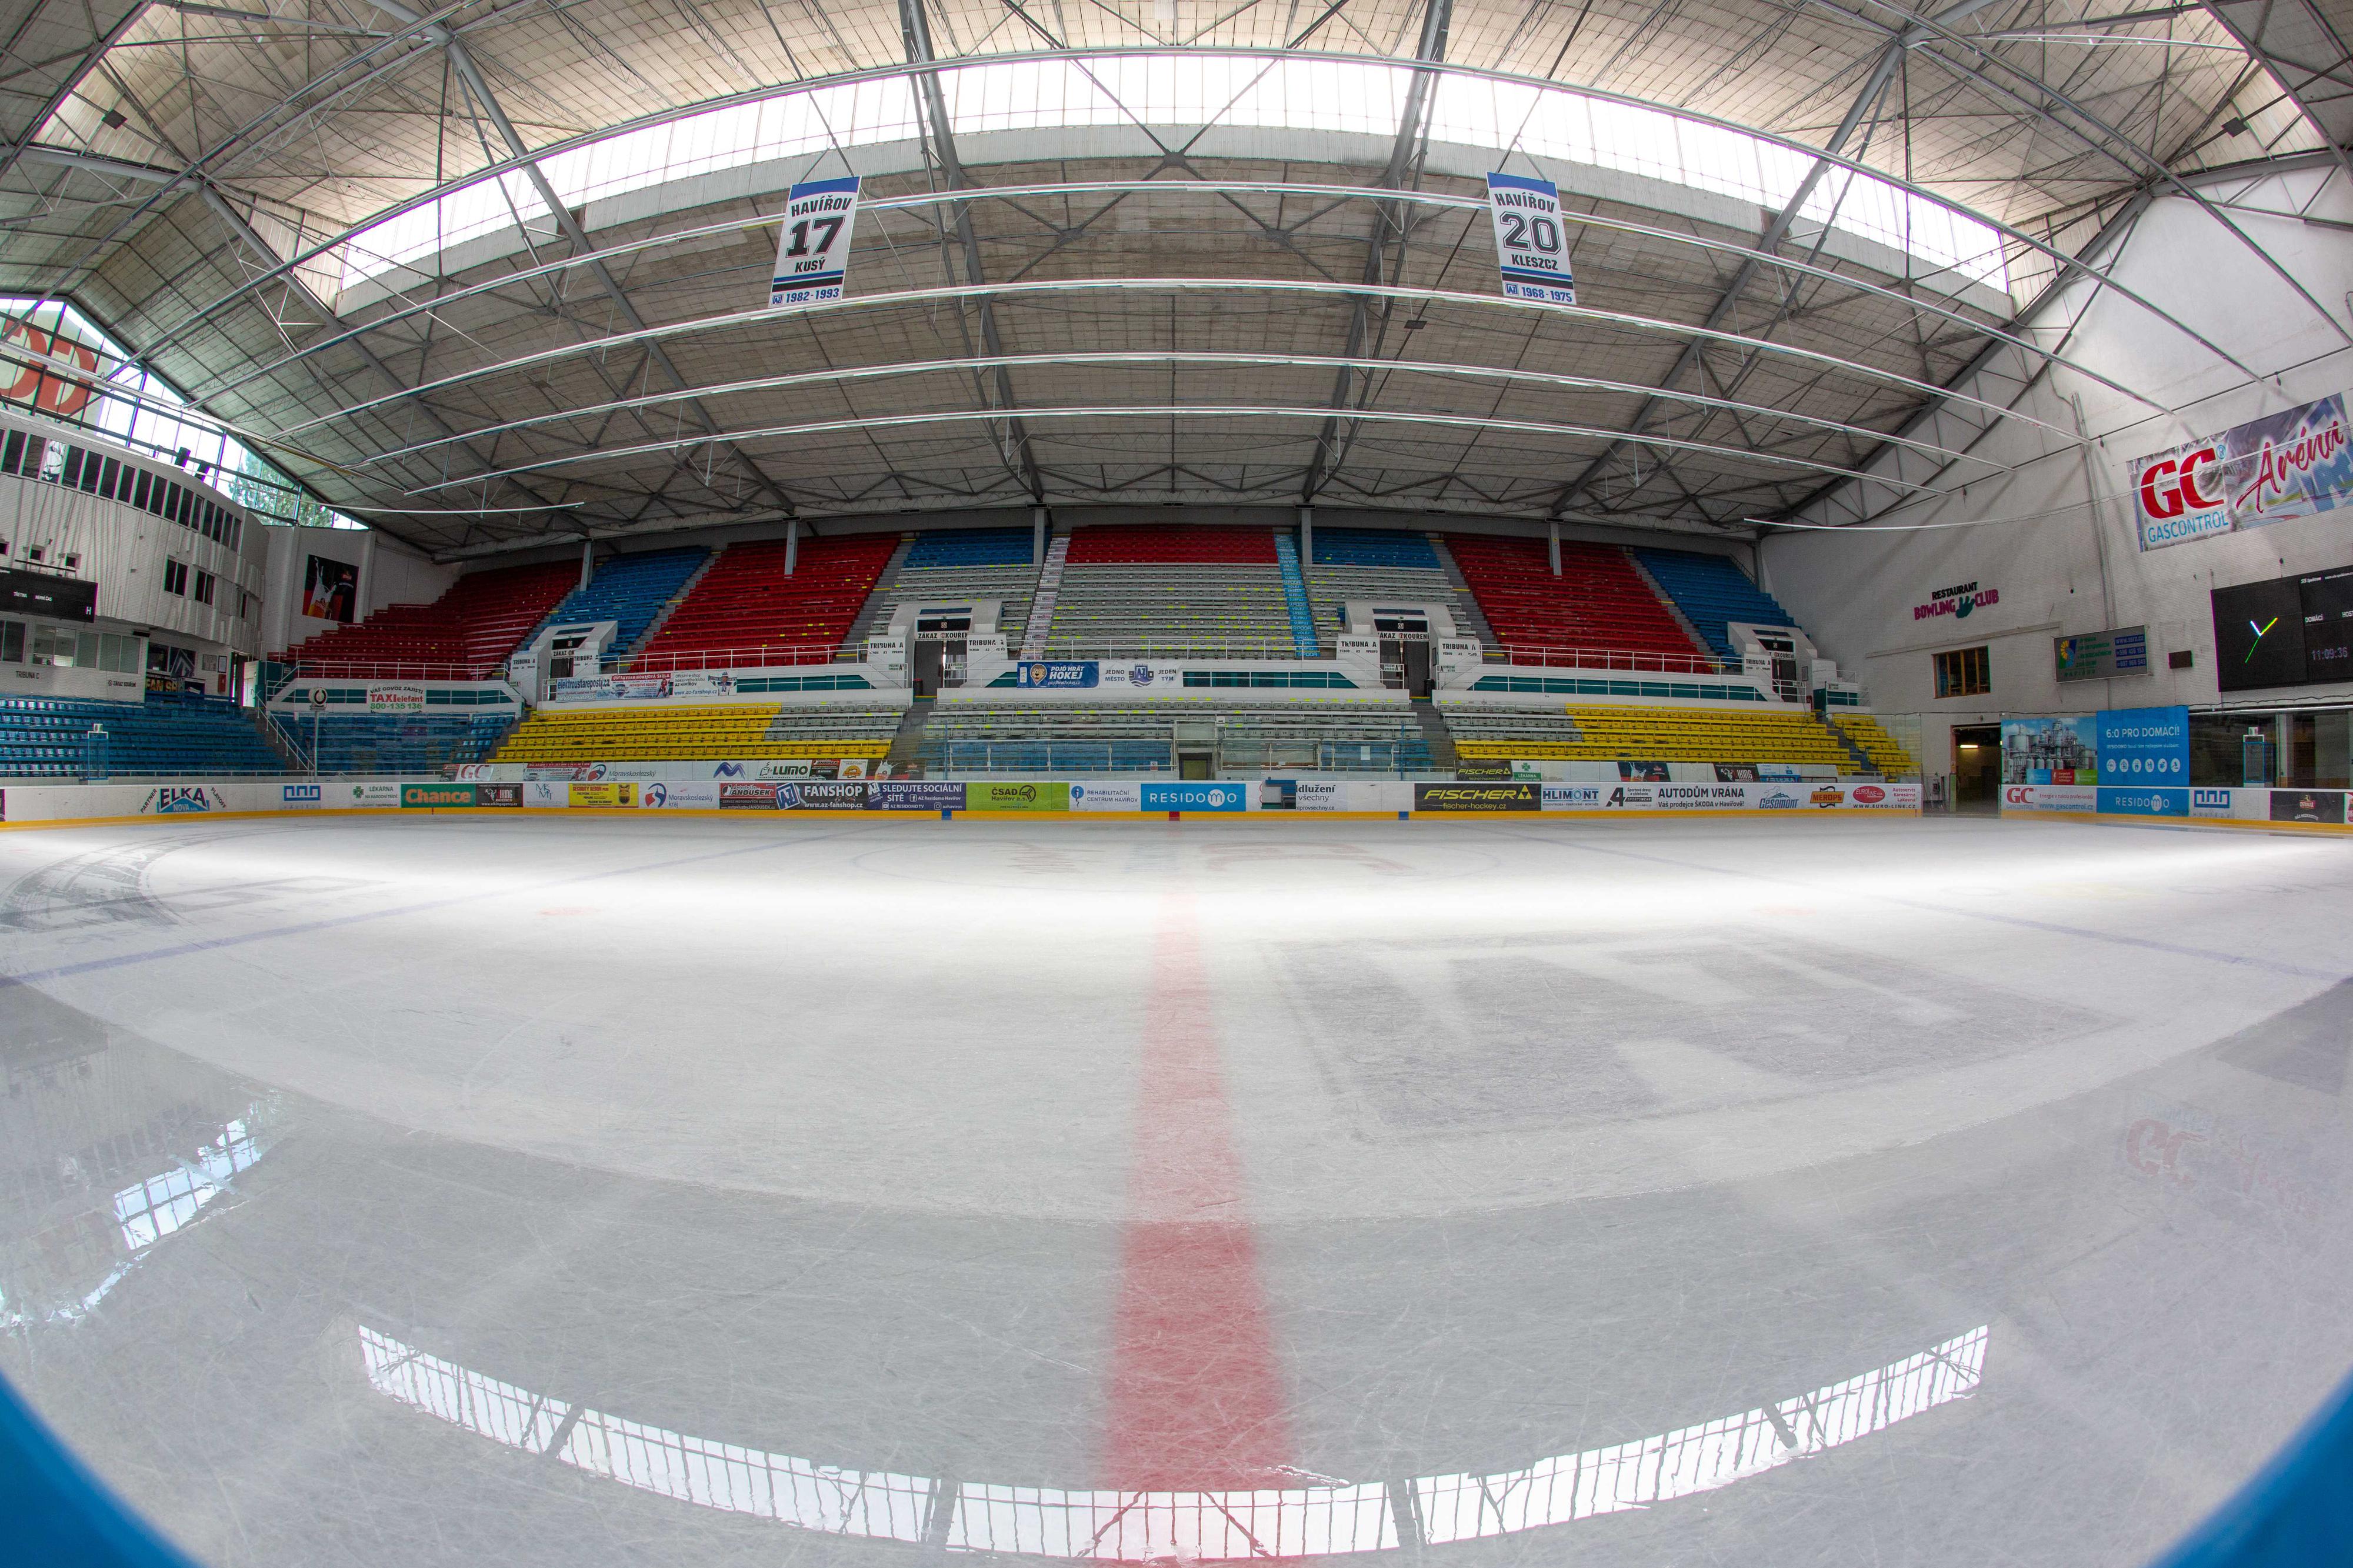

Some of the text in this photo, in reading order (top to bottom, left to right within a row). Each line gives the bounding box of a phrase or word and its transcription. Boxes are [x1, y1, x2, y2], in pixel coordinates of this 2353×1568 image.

[791, 195, 852, 217] HAVÍŘOV
[1495, 192, 1555, 213] HAVÍŘOV
[785, 215, 846, 258] 17
[1499, 211, 1561, 255] 20
[795, 256, 826, 273] KUSÝ
[1511, 254, 1558, 270] KLESZCZ
[2141, 448, 2224, 519] GC
[2148, 510, 2229, 543] GASCONTROL
[1932, 581, 1978, 600] RESTAURANT
[1914, 589, 1999, 620] BOWLING CLUB
[2305, 614, 2323, 623] DOMÁCÍ
[558, 678, 610, 690] elektroustareposty.cz
[2106, 725, 2180, 739] 6:0 PRO DOMÁCÍ!
[461, 765, 490, 779] GC
[773, 766, 808, 776] LUMO
[405, 785, 471, 803] Chance
[722, 785, 772, 796] JANOUSEK
[804, 785, 862, 797] FANSHOP
[924, 784, 962, 792] SOCIÁLNÍ
[992, 787, 1018, 796] ČSAD
[1424, 790, 1517, 800] FISCHER
[1543, 790, 1599, 799] HLIMONT
[1658, 786, 1745, 798] AUTODŮM VRÁNA
[140, 788, 158, 814] PARTNER
[160, 787, 207, 810] ELKA
[211, 787, 226, 809] PLAYOFF
[669, 794, 714, 802] Moravskoslezský
[887, 793, 905, 802] SÍTĚ
[1150, 792, 1237, 805] RESIDOMO
[1298, 794, 1329, 802] všechny
[2007, 788, 2034, 803] GC
[2115, 796, 2169, 809] RESIDOMO
[173, 803, 189, 812] NOVA
